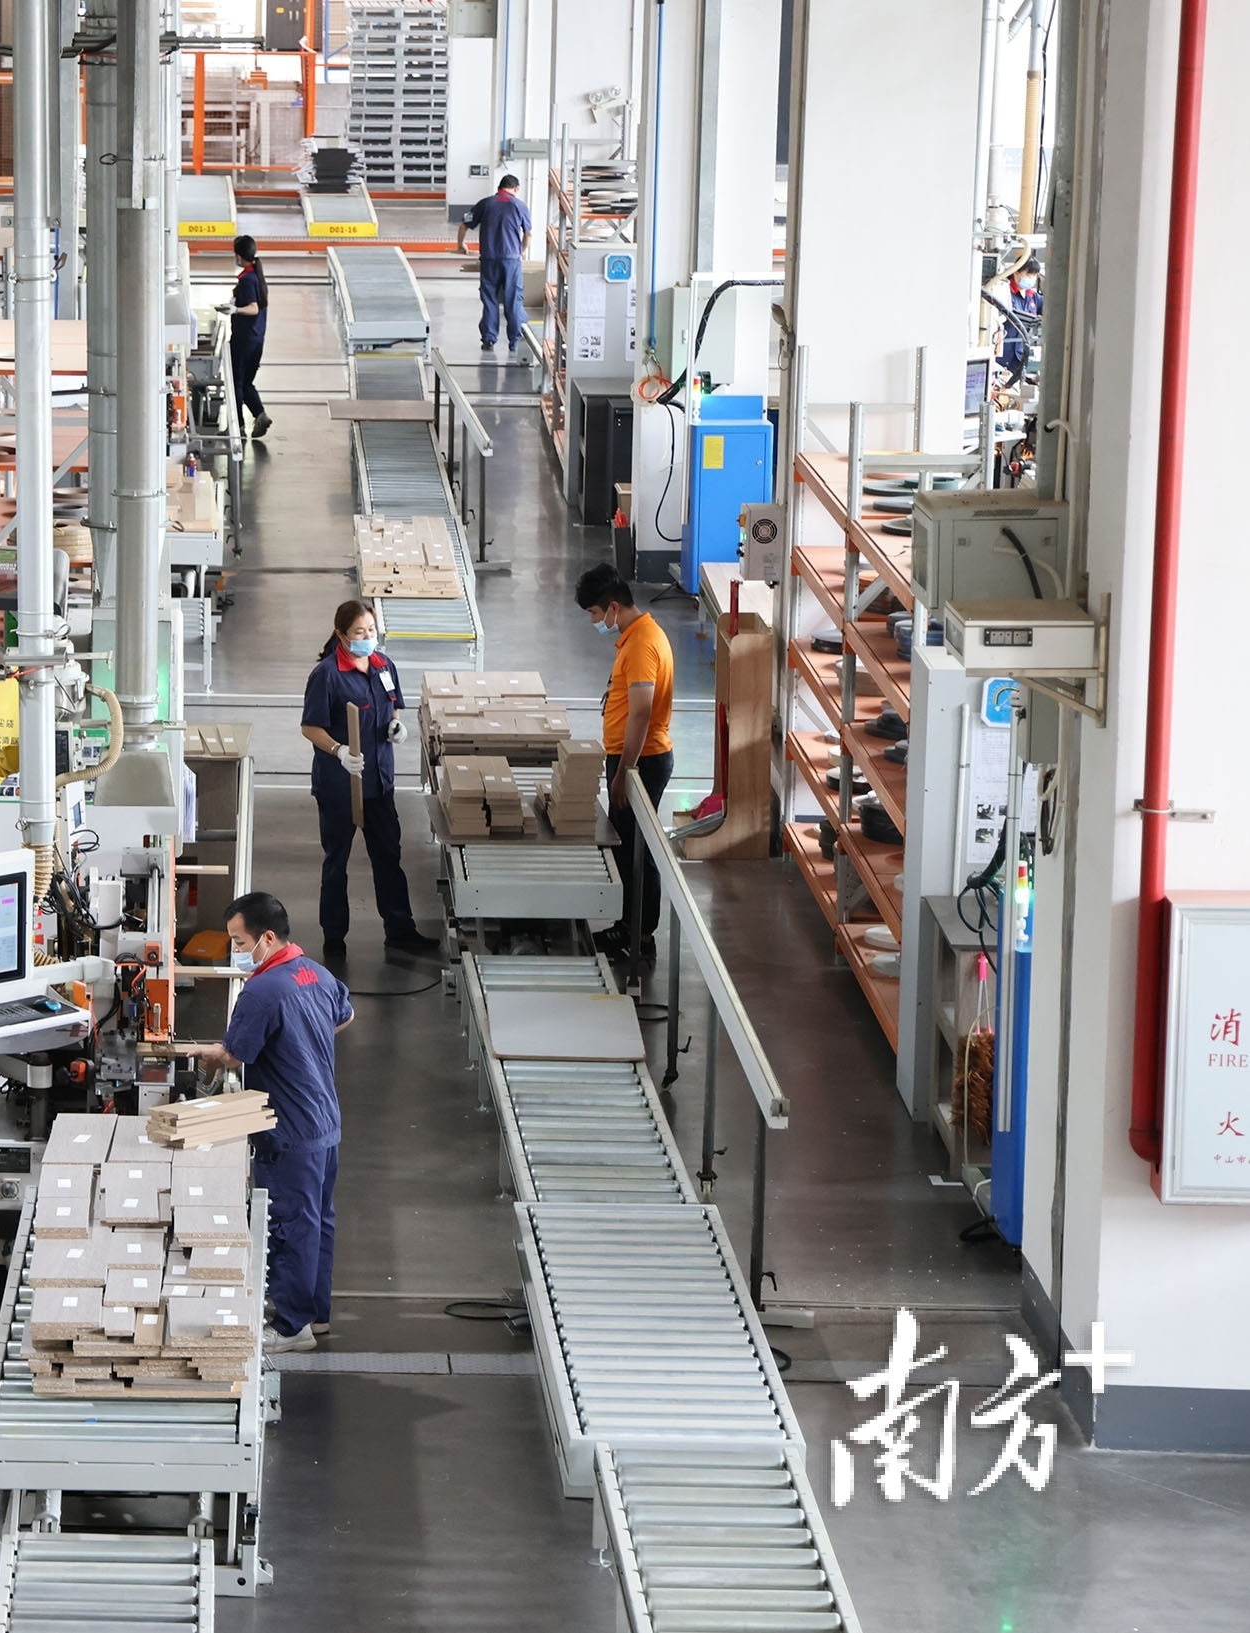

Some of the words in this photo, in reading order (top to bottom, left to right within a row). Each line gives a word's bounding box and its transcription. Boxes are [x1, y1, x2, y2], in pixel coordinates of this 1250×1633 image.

[188, 225, 217, 234] D01-15
[329, 225, 358, 235] D01-16
[1210, 1007, 1242, 1047] 消
[1207, 1052, 1249, 1068] FIRE
[1216, 1111, 1246, 1137] 火
[1213, 1153, 1250, 1165] 中山市
